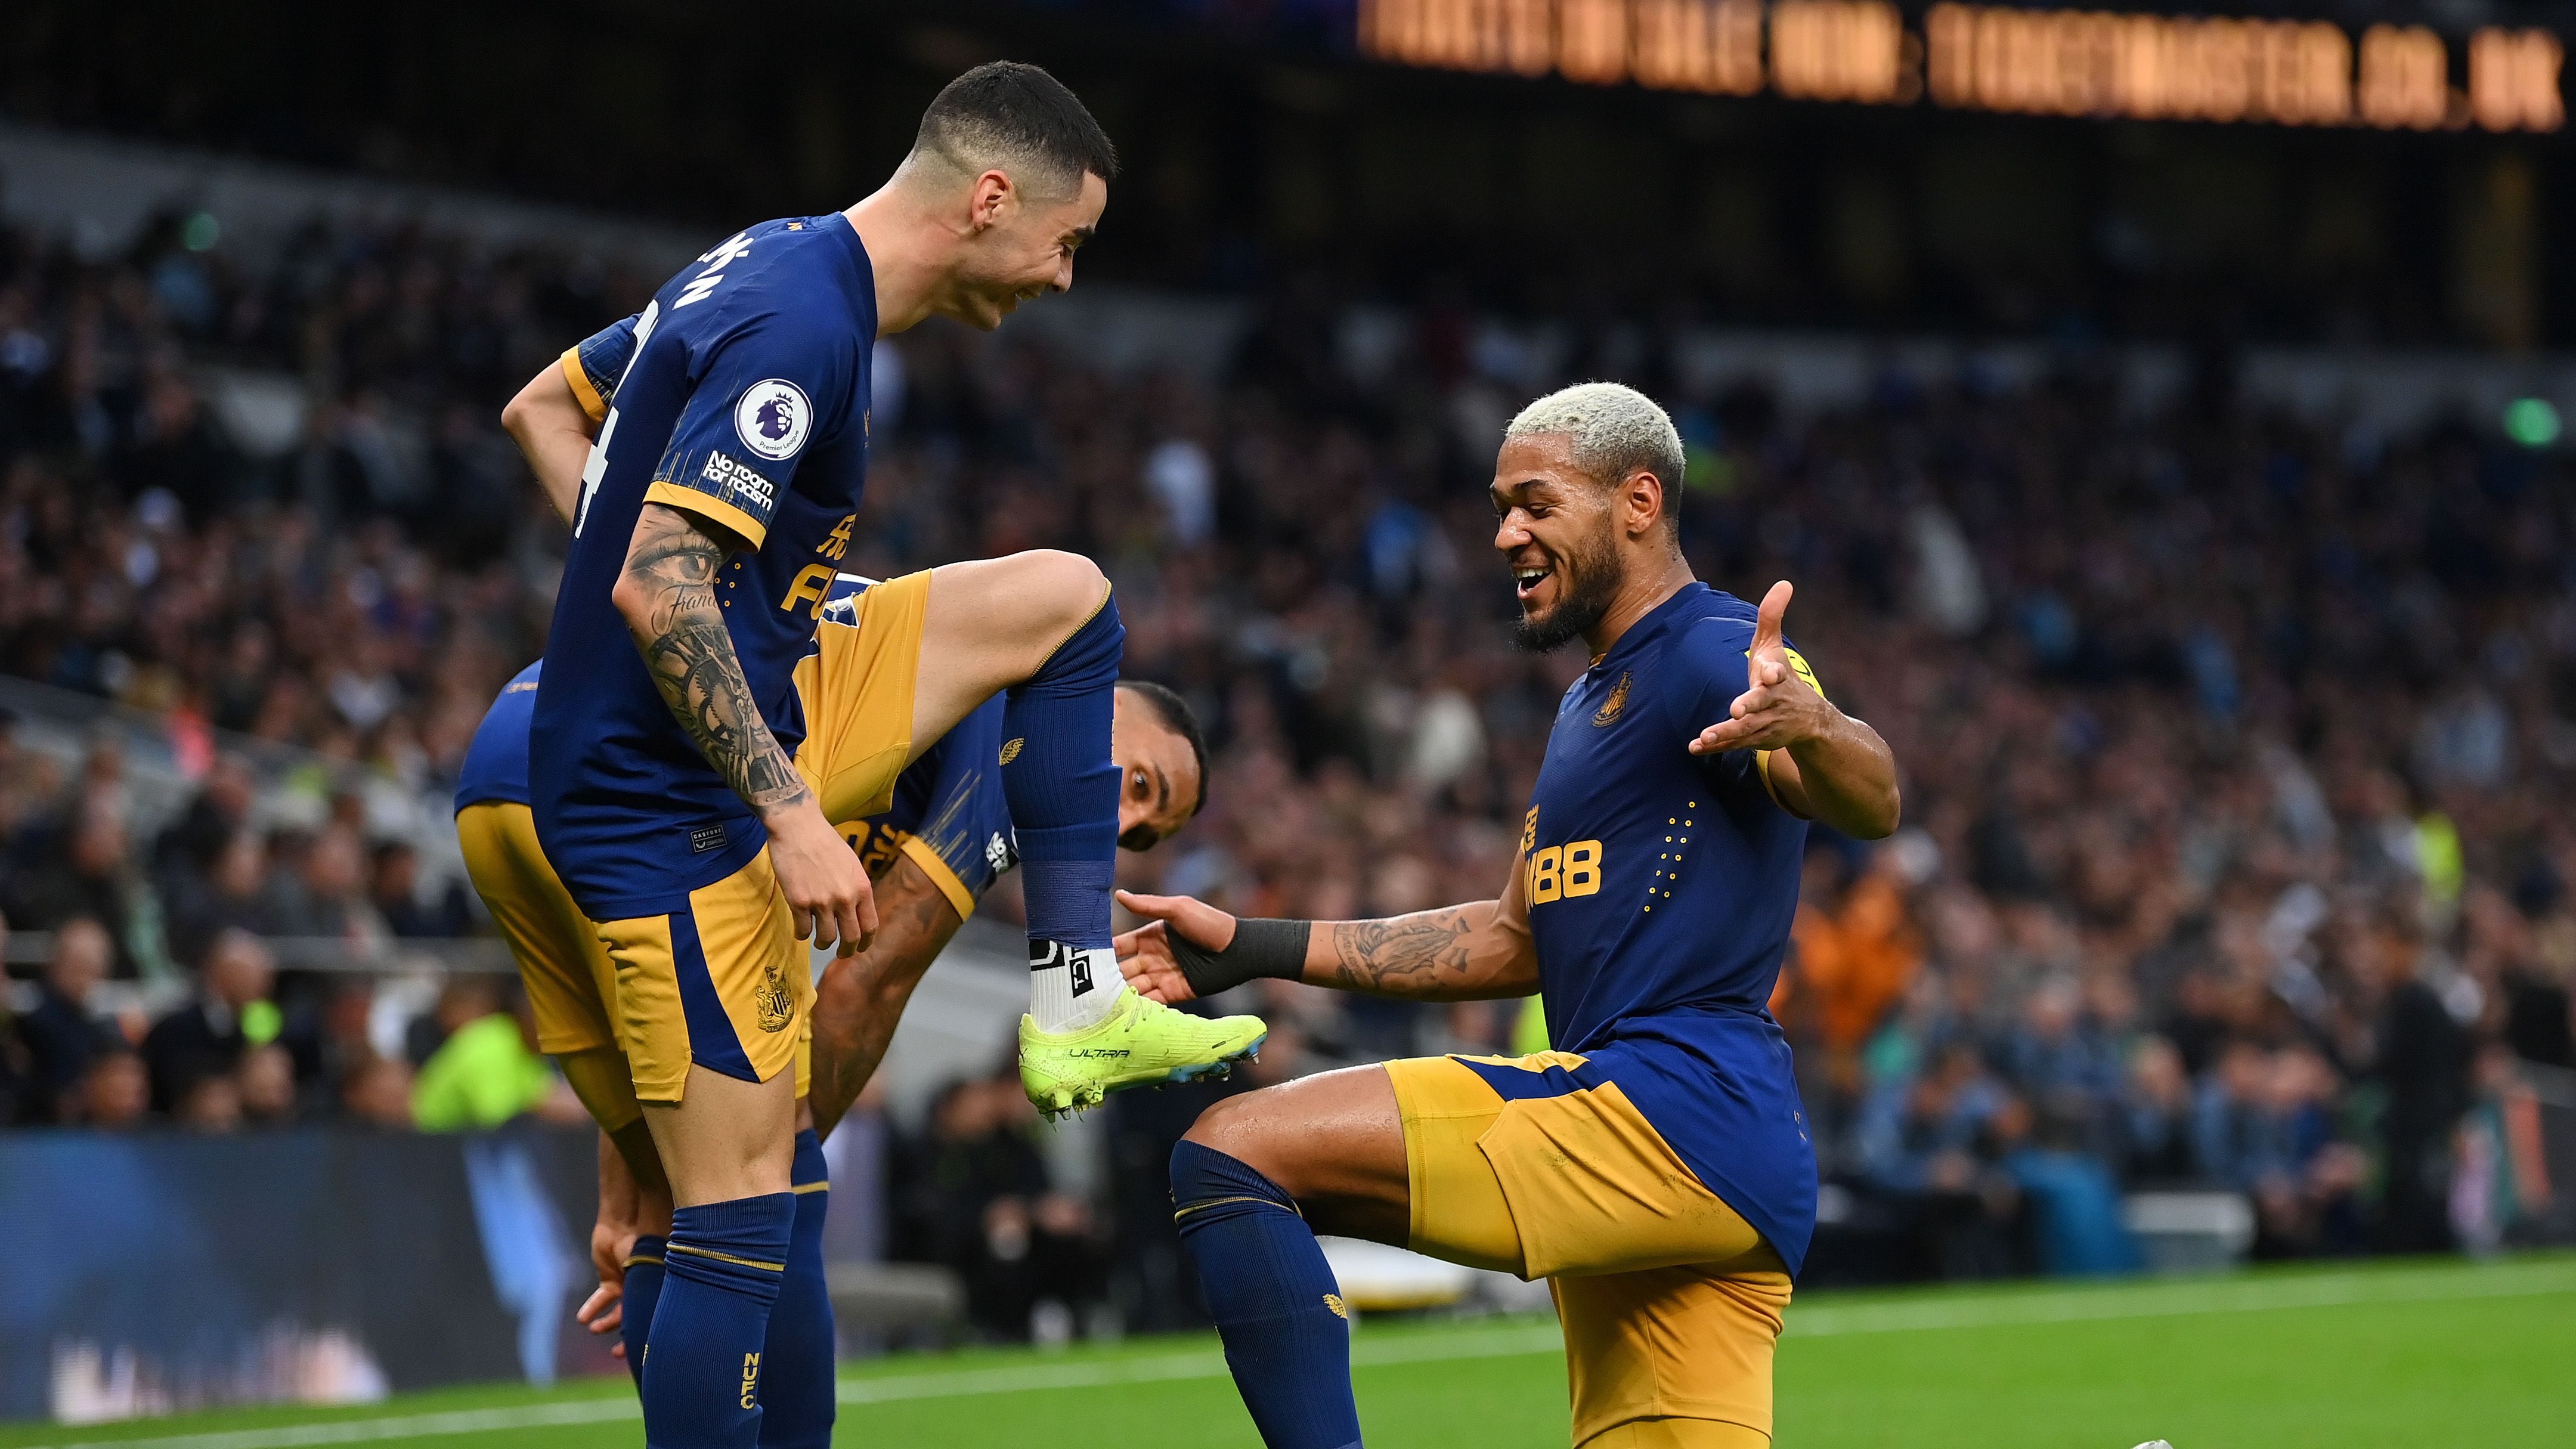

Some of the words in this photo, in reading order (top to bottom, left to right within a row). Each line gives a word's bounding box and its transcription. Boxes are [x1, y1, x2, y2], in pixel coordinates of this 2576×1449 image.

[759, 441, 783, 451] Premier
[783, 430, 800, 448] League
[702, 463, 728, 483] for
[727, 475, 773, 512] racism
[708, 450, 733, 472] No
[733, 464, 773, 496] room
[1069, 1048, 1130, 1060] ULTRA
[741, 1352, 760, 1409] NUFC
